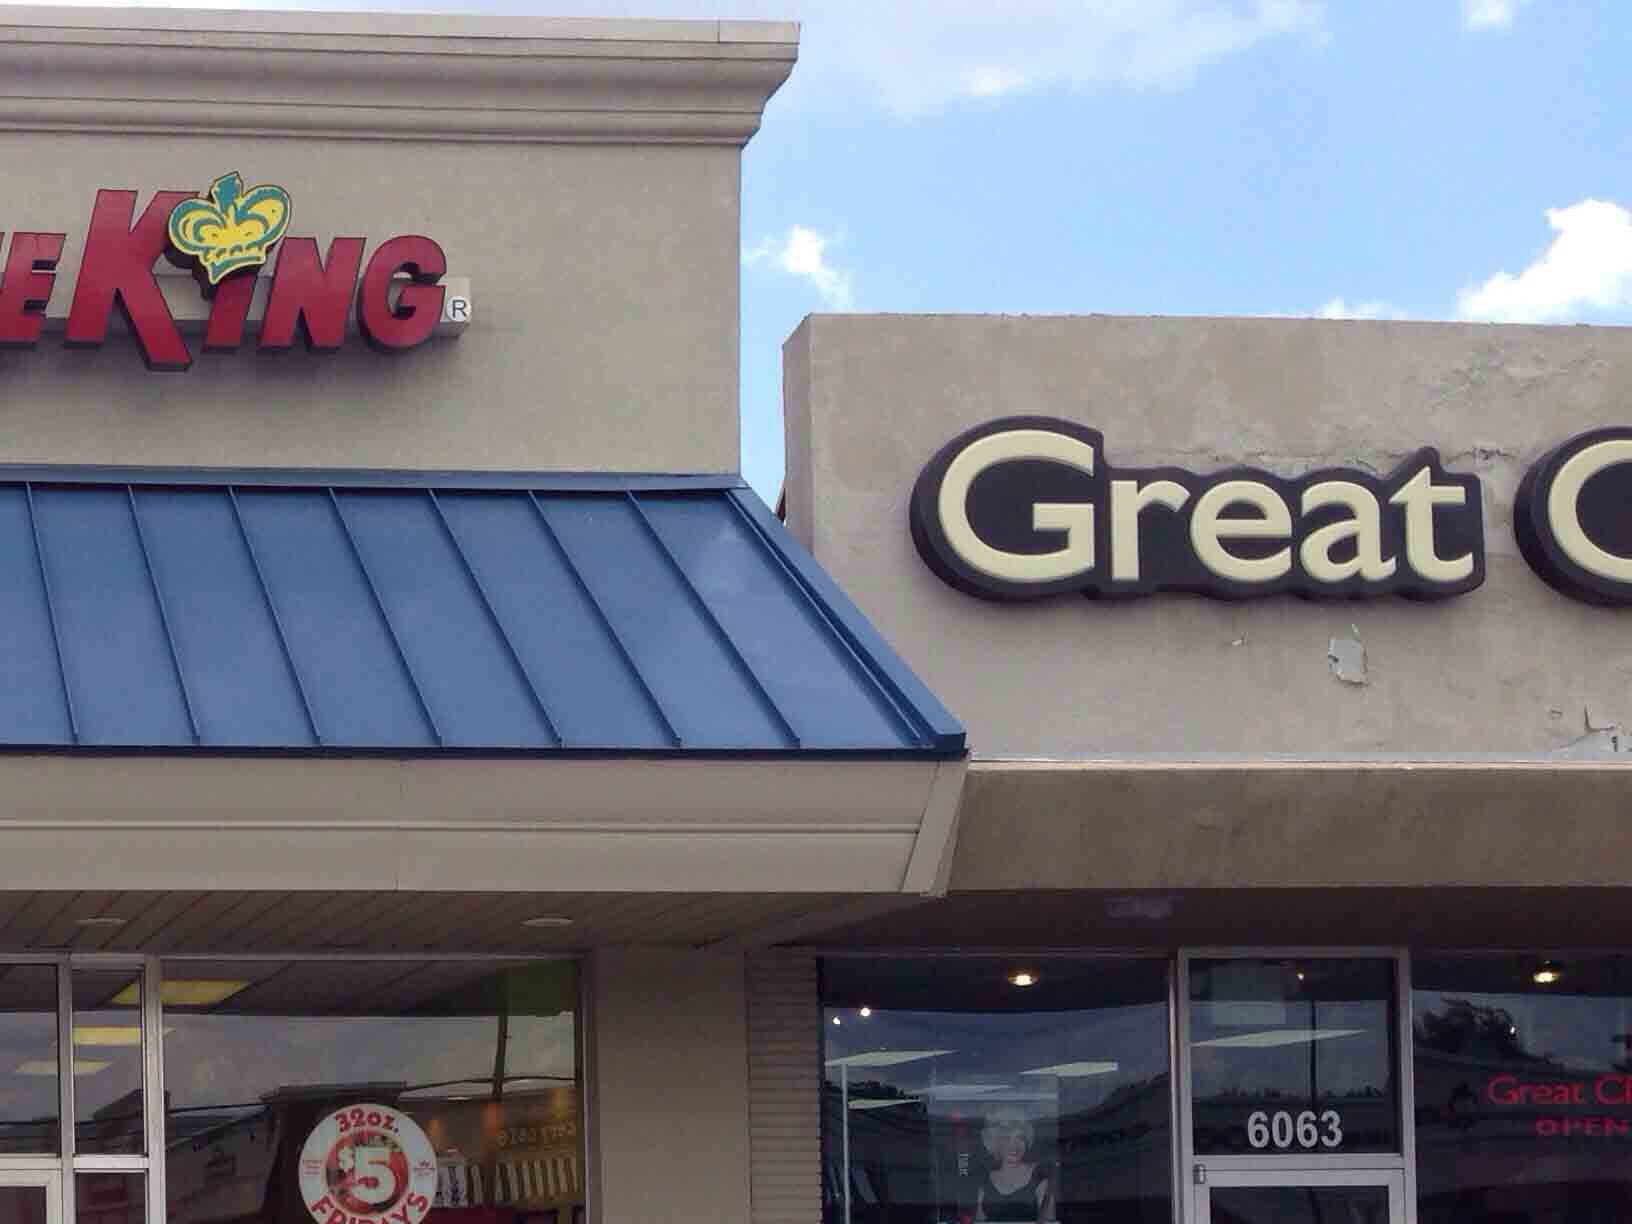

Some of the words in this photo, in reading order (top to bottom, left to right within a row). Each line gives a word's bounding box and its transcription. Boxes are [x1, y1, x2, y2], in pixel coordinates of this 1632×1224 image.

[938, 428, 1473, 583] Great
[1488, 1073, 1585, 1104] Great
[1248, 1110, 1343, 1148] 6063
[1535, 1118, 1630, 1137] OPEN
